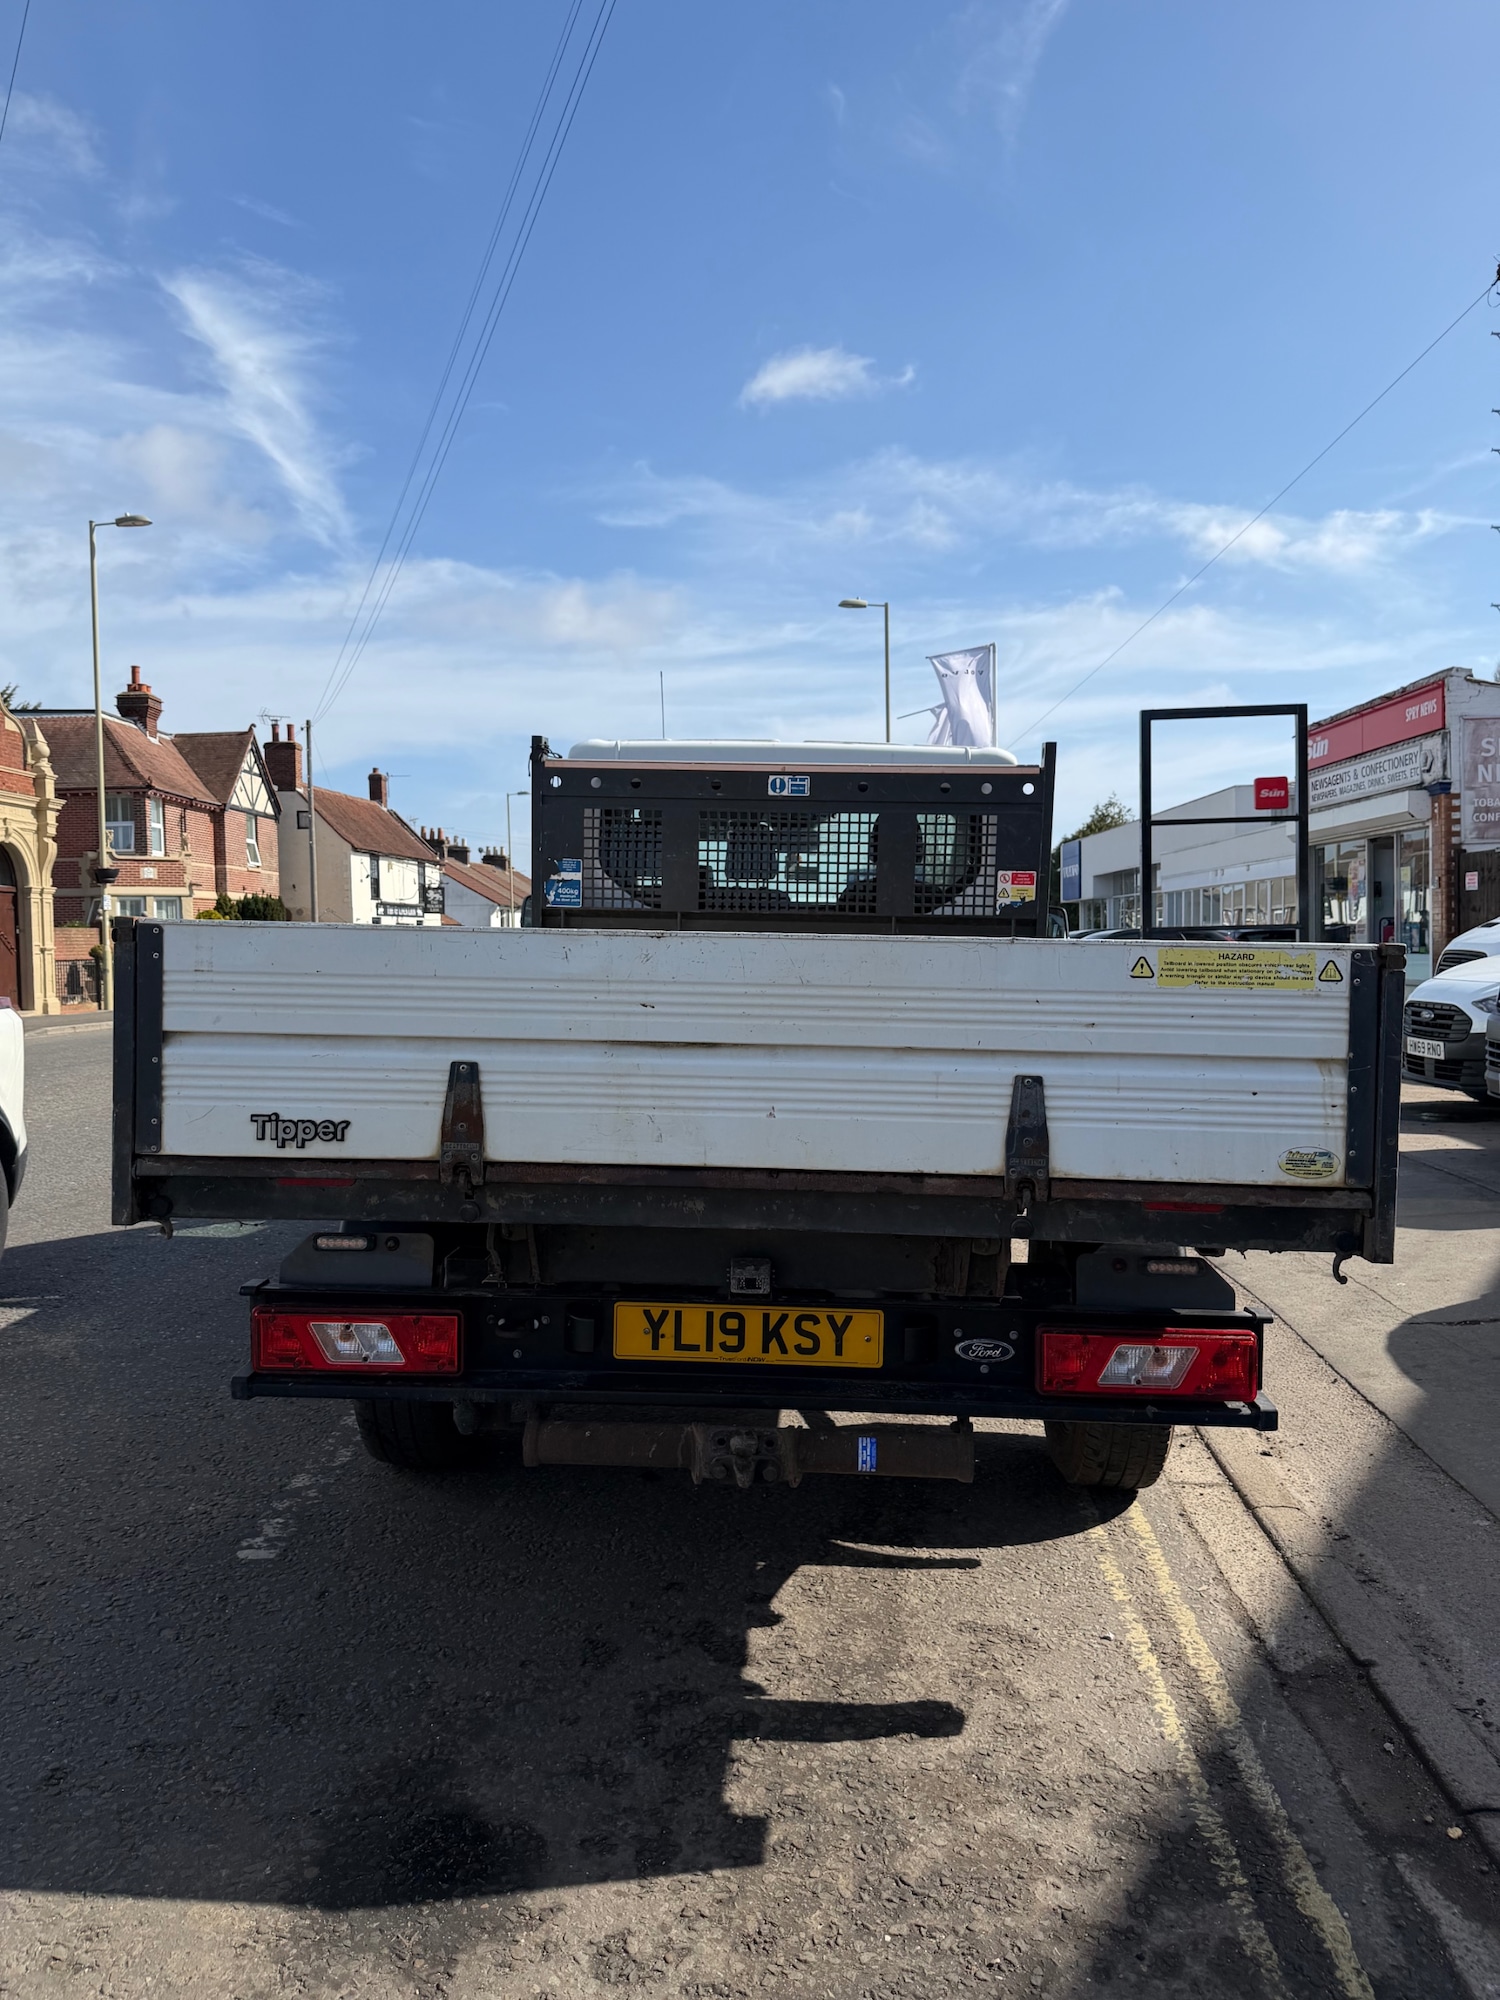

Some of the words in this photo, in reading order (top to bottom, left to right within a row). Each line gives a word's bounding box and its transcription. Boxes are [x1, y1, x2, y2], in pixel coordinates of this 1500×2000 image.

[1405, 704, 1419, 722] SPRY
[1420, 698, 1437, 717] NEWS
[1311, 771, 1351, 792] NEWSAGENTS
[1353, 768, 1359, 781] &
[1361, 750, 1418, 778] CONFECTIONERY
[557, 888, 579, 896] 400kg
[250, 1112, 351, 1148] Tipper
[643, 1309, 746, 1353] YL19
[761, 1312, 853, 1357] KSY
[968, 1343, 1002, 1358] Ford
